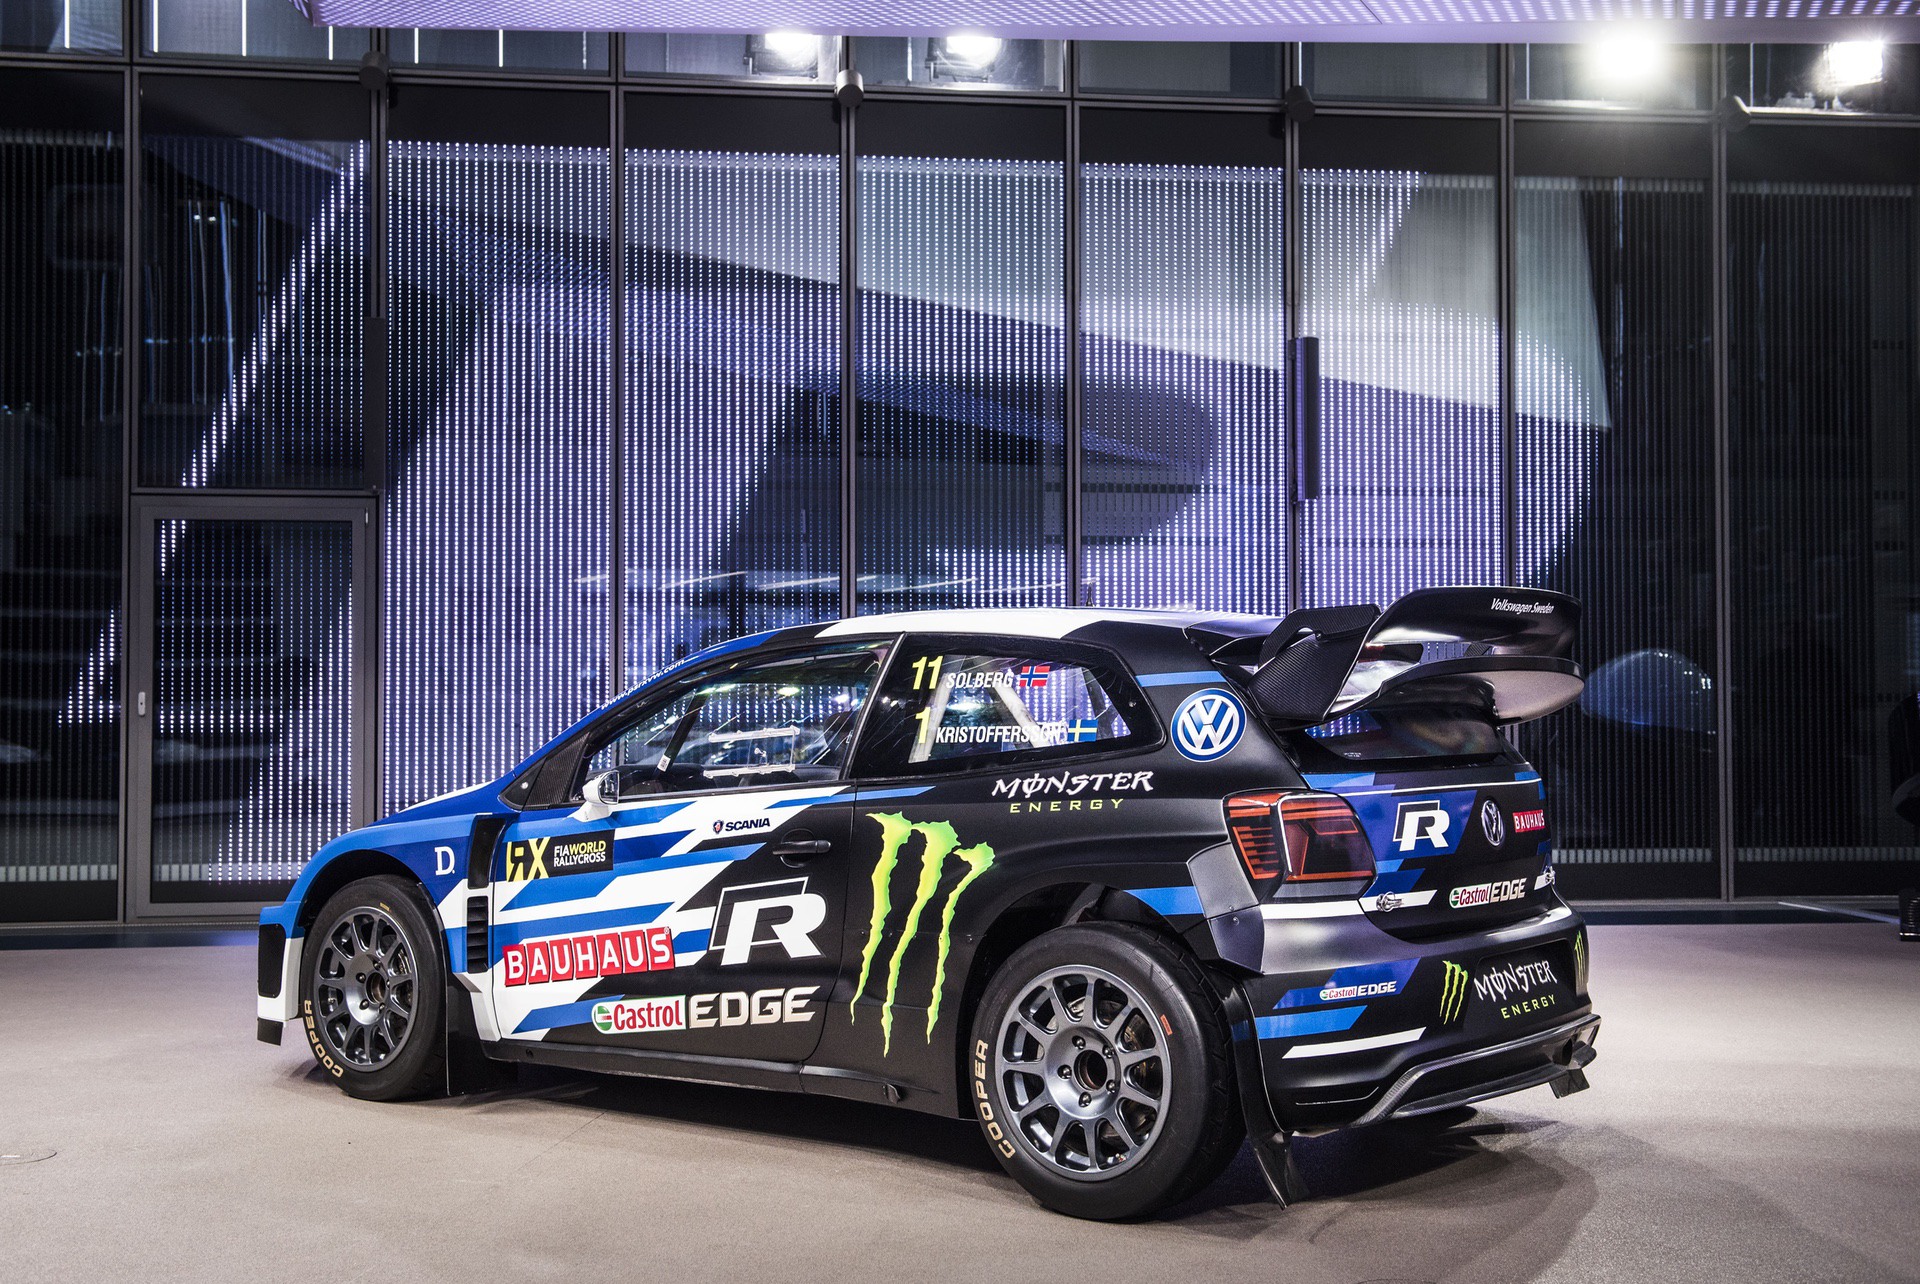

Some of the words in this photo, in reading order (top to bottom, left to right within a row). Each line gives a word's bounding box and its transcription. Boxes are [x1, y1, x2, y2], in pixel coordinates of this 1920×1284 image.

[1490, 598, 1533, 615] Volkswagen
[1531, 602, 1555, 614] Sweden
[911, 655, 944, 690] 11
[945, 671, 1014, 689] SOLBERG
[914, 706, 931, 744] 1
[1009, 798, 1124, 814] ENERGY
[724, 817, 771, 832] SCANIA
[1513, 811, 1546, 831] BAUHAUS
[553, 851, 606, 868] RALLYCROSS
[1459, 885, 1490, 906] Castrol
[1490, 878, 1527, 903] EDGE
[506, 932, 672, 979] BAUHAUS
[1328, 987, 1356, 999] Castrol
[1357, 981, 1397, 996] EDGE
[613, 999, 683, 1031] Castrol
[689, 985, 821, 1029] EDGE
[1500, 994, 1556, 1019] ENERGY
[303, 999, 344, 1078] COOPER
[975, 1039, 1017, 1159] COOPER
